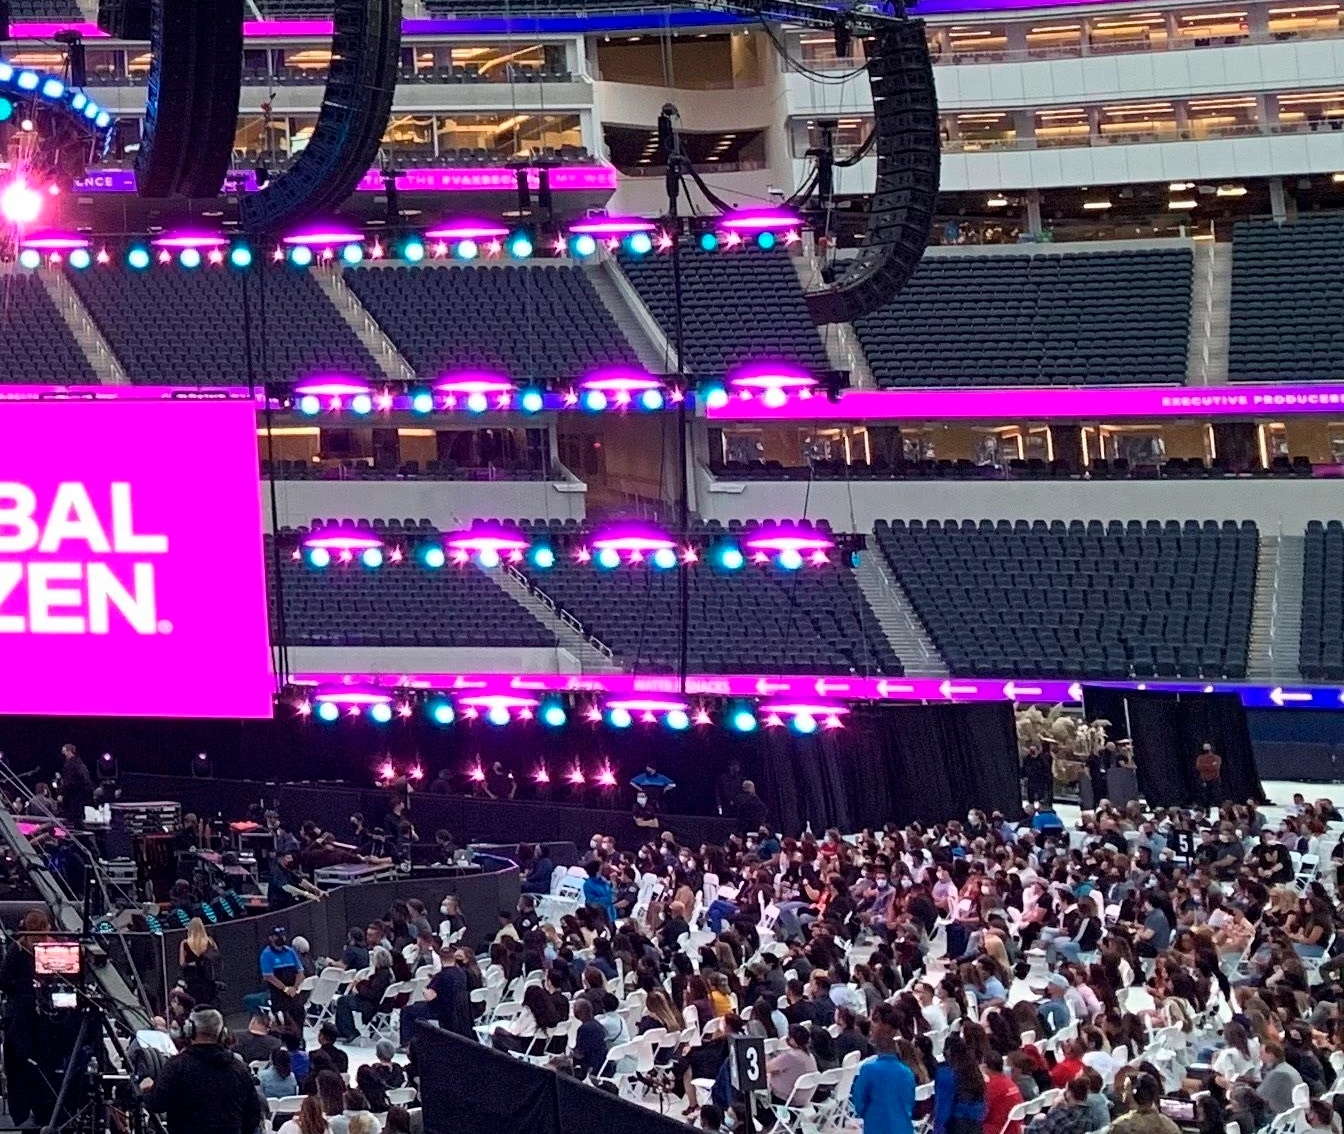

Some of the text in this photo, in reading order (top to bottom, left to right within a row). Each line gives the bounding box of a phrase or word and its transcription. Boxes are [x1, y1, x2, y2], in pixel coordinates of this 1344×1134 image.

[1161, 395, 1248, 407] EXECUTIVE
[1178, 833, 1189, 853] 5
[745, 1046, 760, 1082] 3
